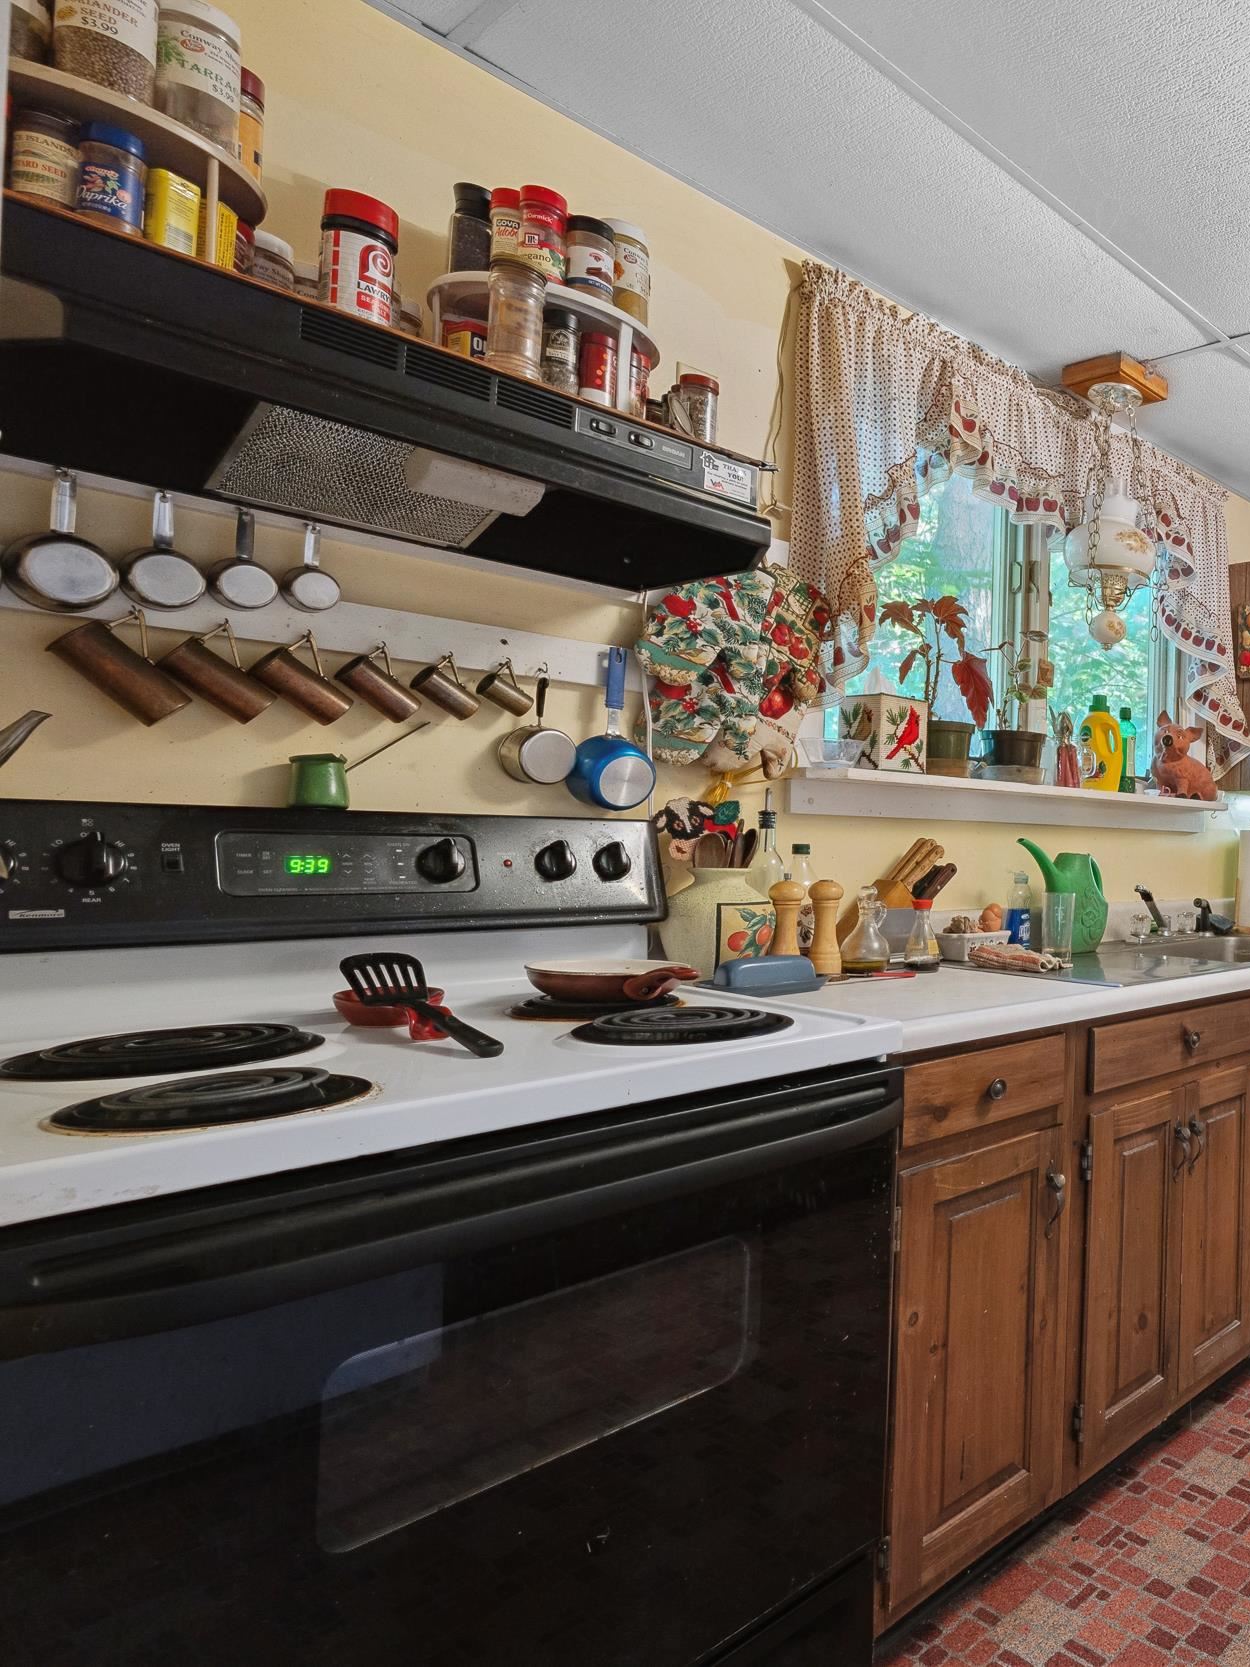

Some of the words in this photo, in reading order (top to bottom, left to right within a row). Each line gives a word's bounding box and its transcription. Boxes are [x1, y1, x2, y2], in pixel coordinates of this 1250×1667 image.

[80, 7, 118, 25] SEED
[81, 16, 119, 35] $3.99
[176, 58, 240, 98] TARRAG
[41, 164, 67, 178] SEED
[76, 184, 128, 209] Paprika
[496, 219, 519, 228] GOYA
[525, 252, 551, 263] gano
[289, 858, 330, 874] 9:39
[18, 910, 64, 919] Kenmore
